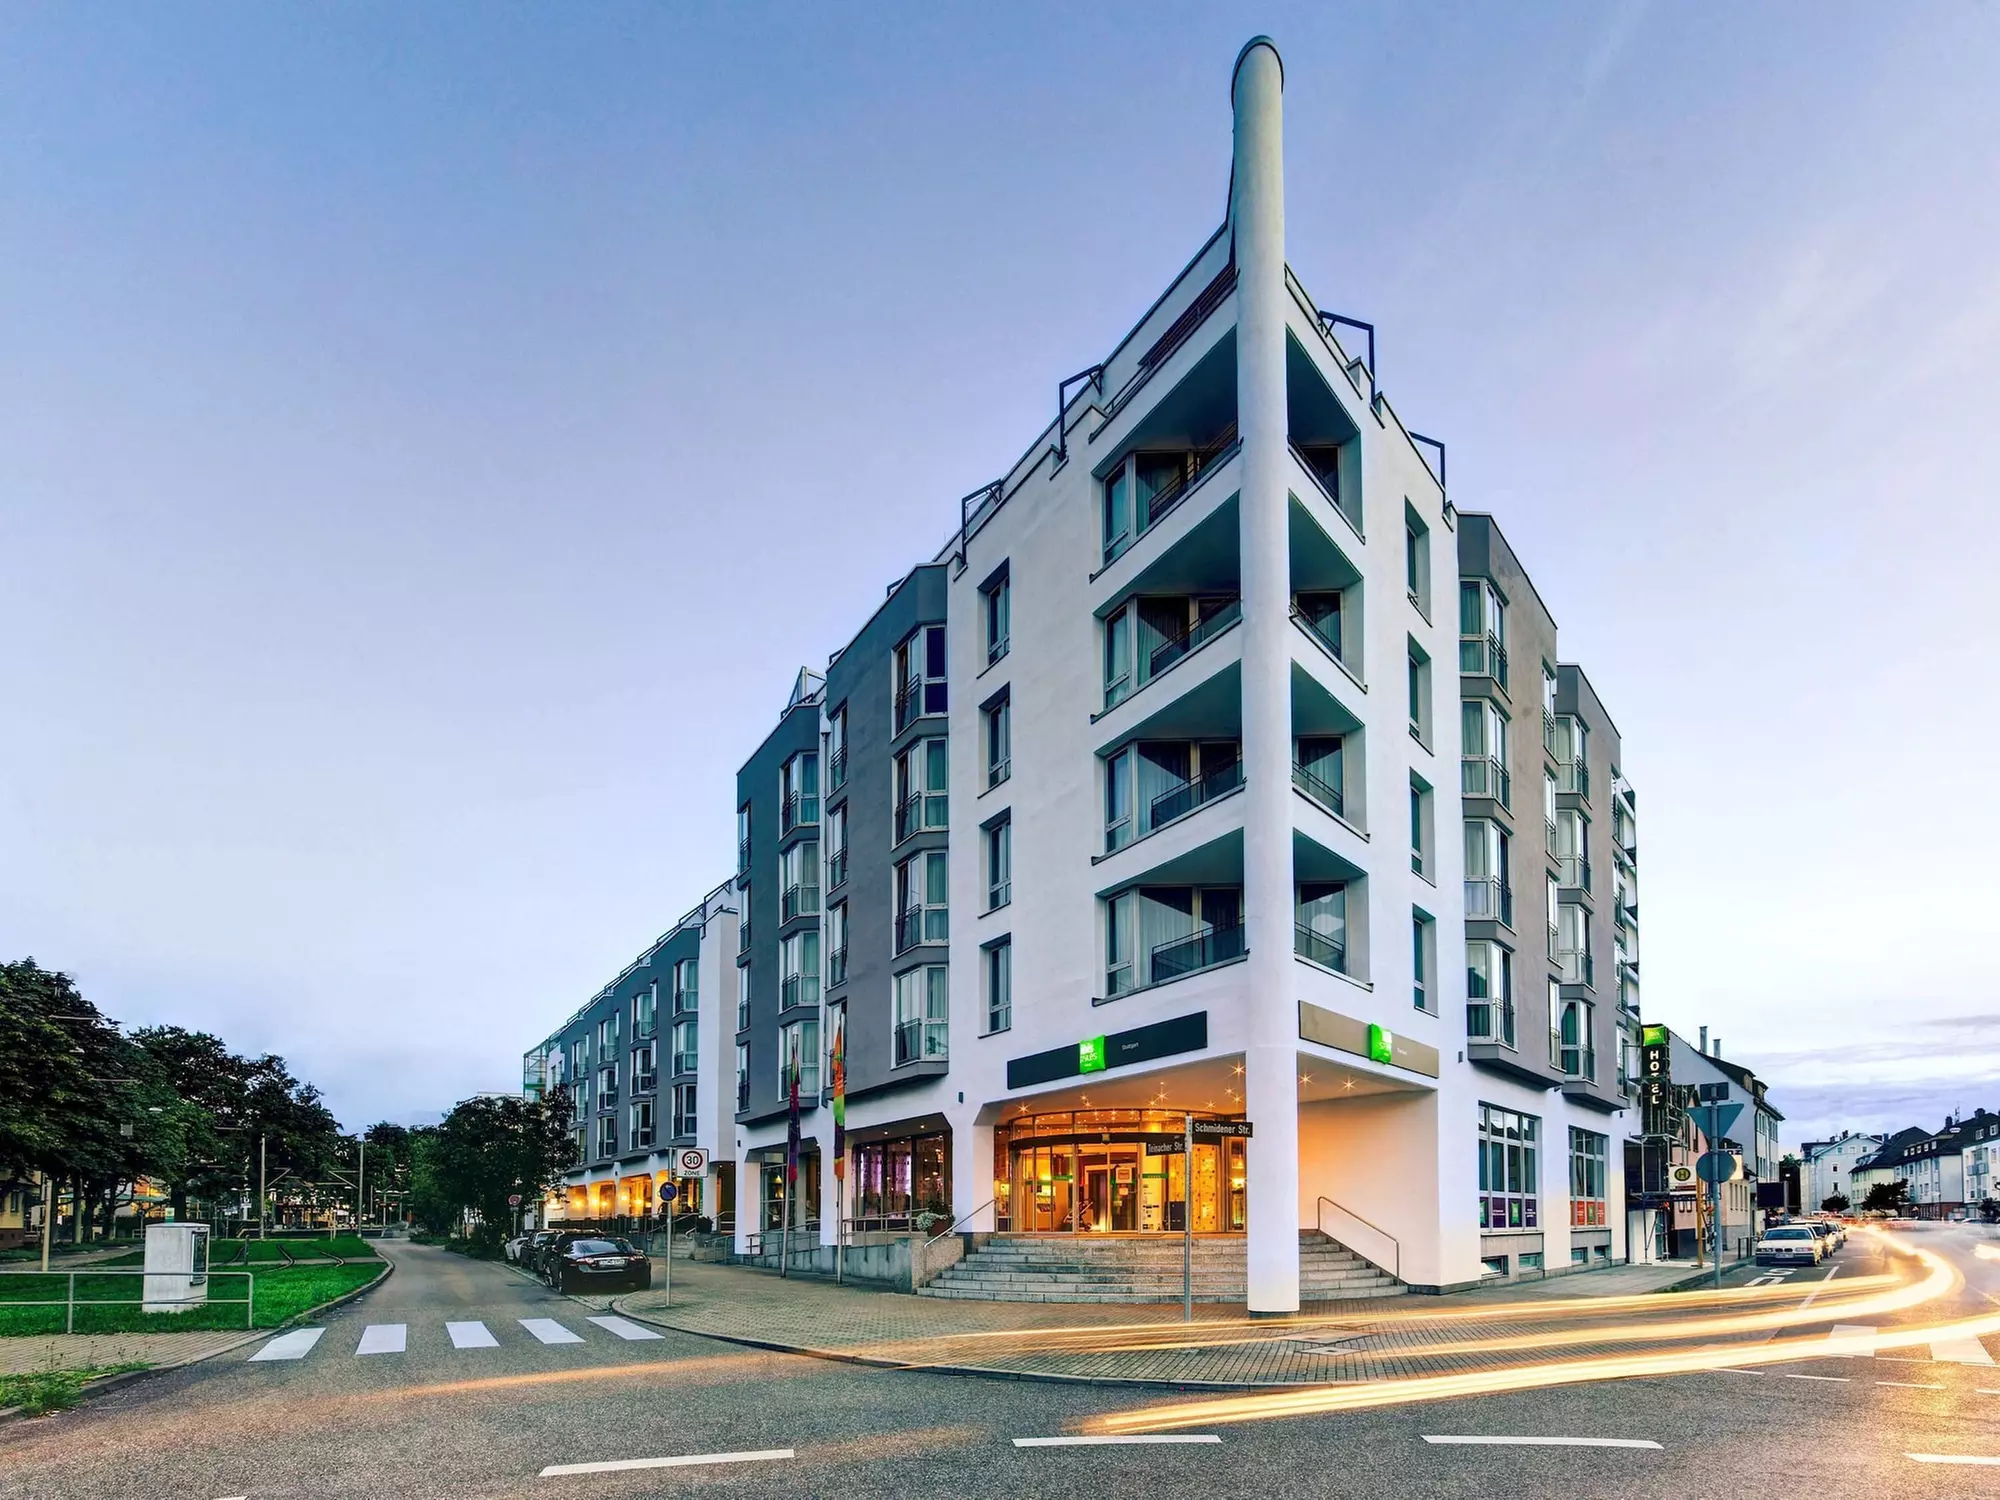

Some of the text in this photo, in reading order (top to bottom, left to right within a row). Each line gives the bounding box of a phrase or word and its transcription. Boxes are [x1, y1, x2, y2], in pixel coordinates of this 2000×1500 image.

[1194, 1123, 1251, 1135] Schmidener Str.
[1147, 1141, 1184, 1153] Teinacher Str.
[686, 1155, 699, 1165] 30
